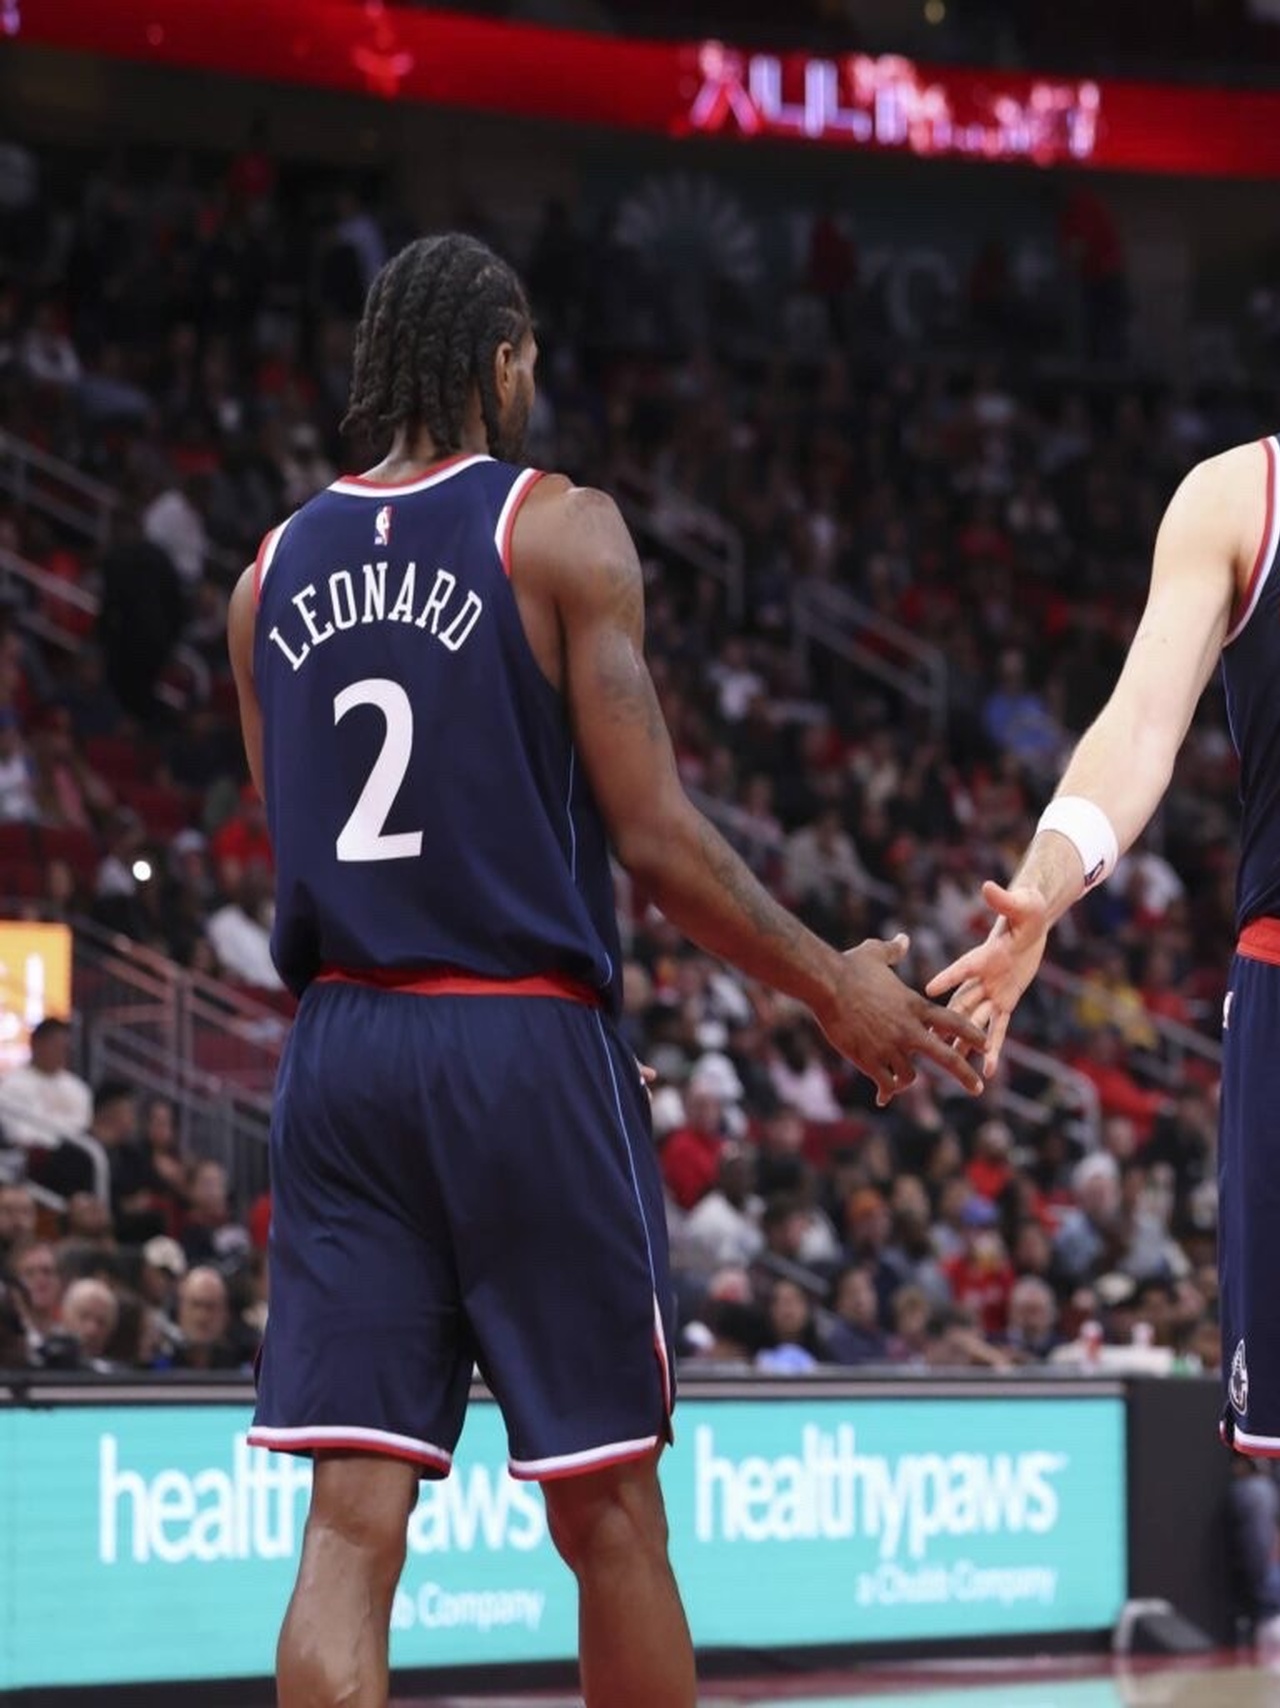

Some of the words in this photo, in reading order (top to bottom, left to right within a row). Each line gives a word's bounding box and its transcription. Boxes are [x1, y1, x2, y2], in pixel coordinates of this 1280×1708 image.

[269, 562, 482, 671] LEONARD
[333, 678, 423, 861] 2
[695, 1423, 1060, 1559] healthypaws
[417, 1581, 545, 1632] Company
[952, 1559, 1057, 1606] Company
